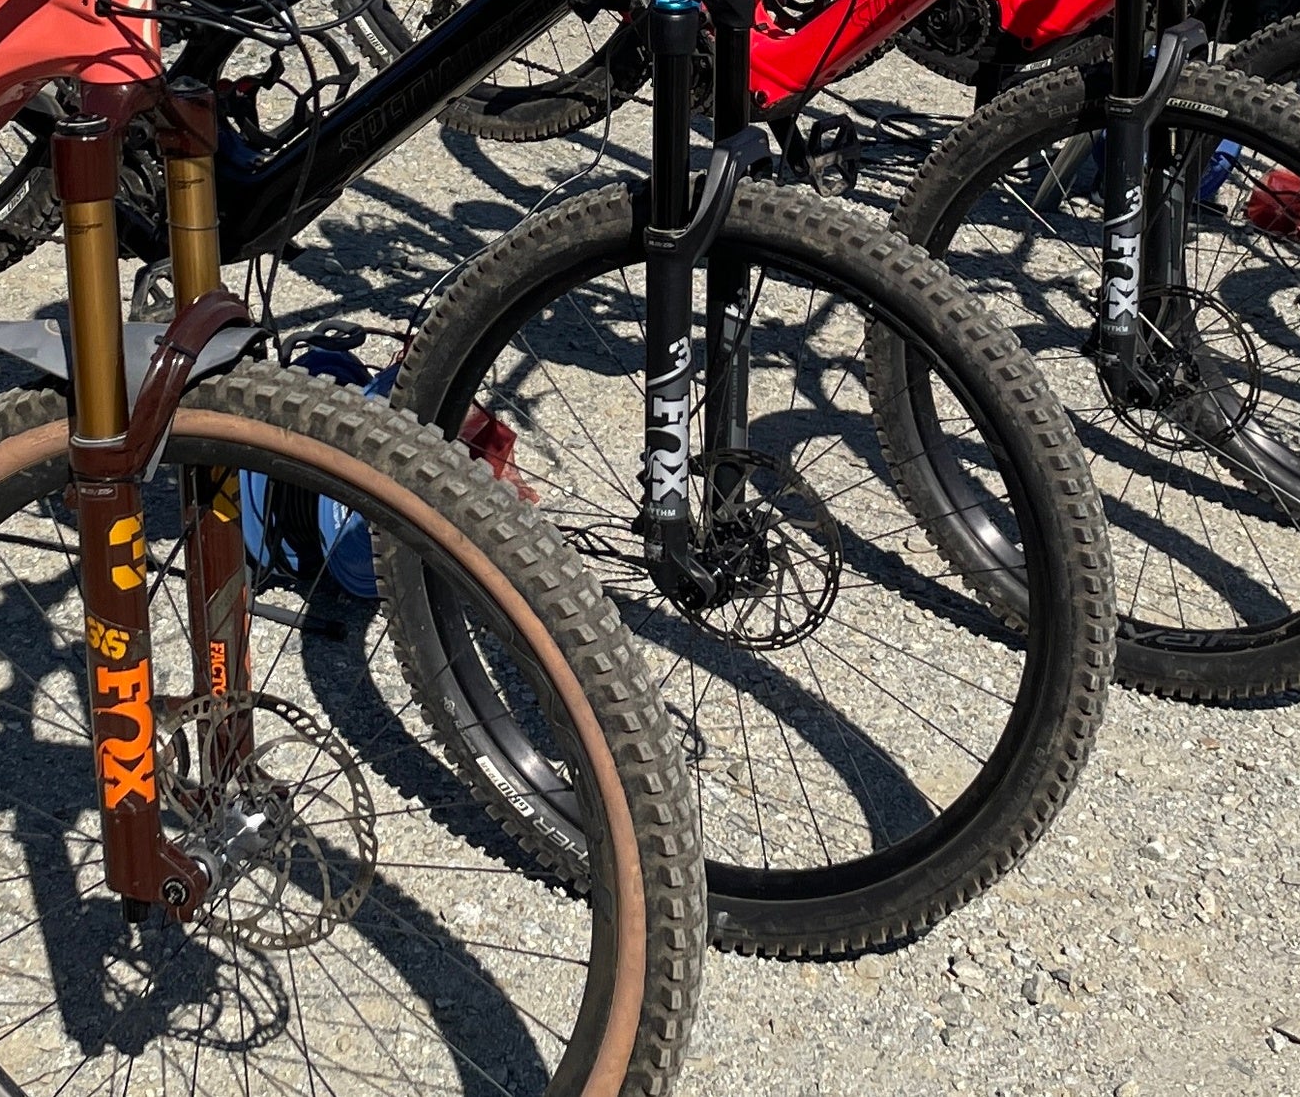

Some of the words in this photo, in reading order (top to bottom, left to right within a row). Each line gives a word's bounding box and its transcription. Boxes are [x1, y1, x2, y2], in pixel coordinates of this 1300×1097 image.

[1102, 233, 1141, 320] FOX
[647, 394, 690, 503] FOX
[92, 658, 157, 810] FOX
